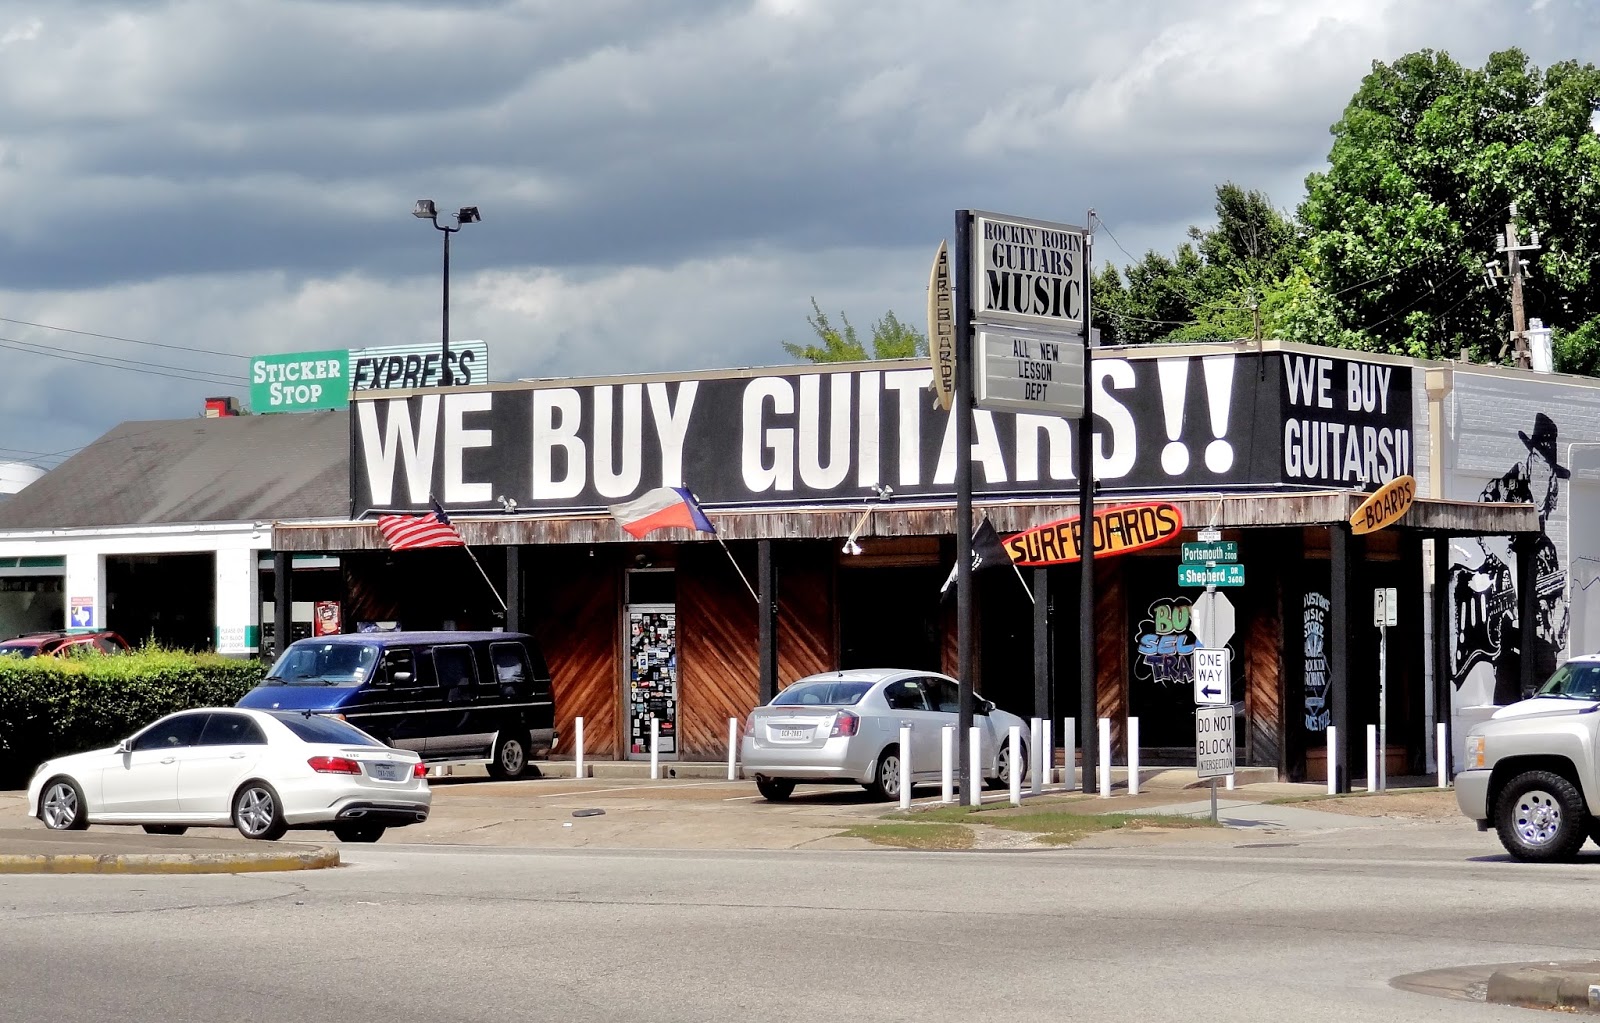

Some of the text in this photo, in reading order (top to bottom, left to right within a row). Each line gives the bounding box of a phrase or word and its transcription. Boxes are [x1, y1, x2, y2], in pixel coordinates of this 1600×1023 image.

[984, 222, 1081, 252] ROCKIN' ROBIN
[992, 243, 1073, 277] GUITARS
[986, 269, 1080, 320] MUSIC
[1013, 339, 1059, 362] ALL NEW
[353, 350, 475, 390] EXPRESS
[1018, 360, 1052, 381] LESSON
[1025, 382, 1048, 401] DEPT
[1283, 354, 1392, 414] WE BUY
[357, 392, 492, 506] WE
[533, 380, 699, 500] BUY
[1184, 546, 1223, 560] Portsmouth
[1180, 566, 1239, 586] S Shepherd DR
[1227, 575, 1243, 584] 3600
[1153, 604, 1193, 633] BU
[1144, 654, 1194, 683] TRA
[1199, 653, 1222, 667] ONE
[1198, 669, 1222, 682] WAY
[1199, 715, 1232, 733] DO NOT
[1199, 738, 1233, 756] BLOCK
